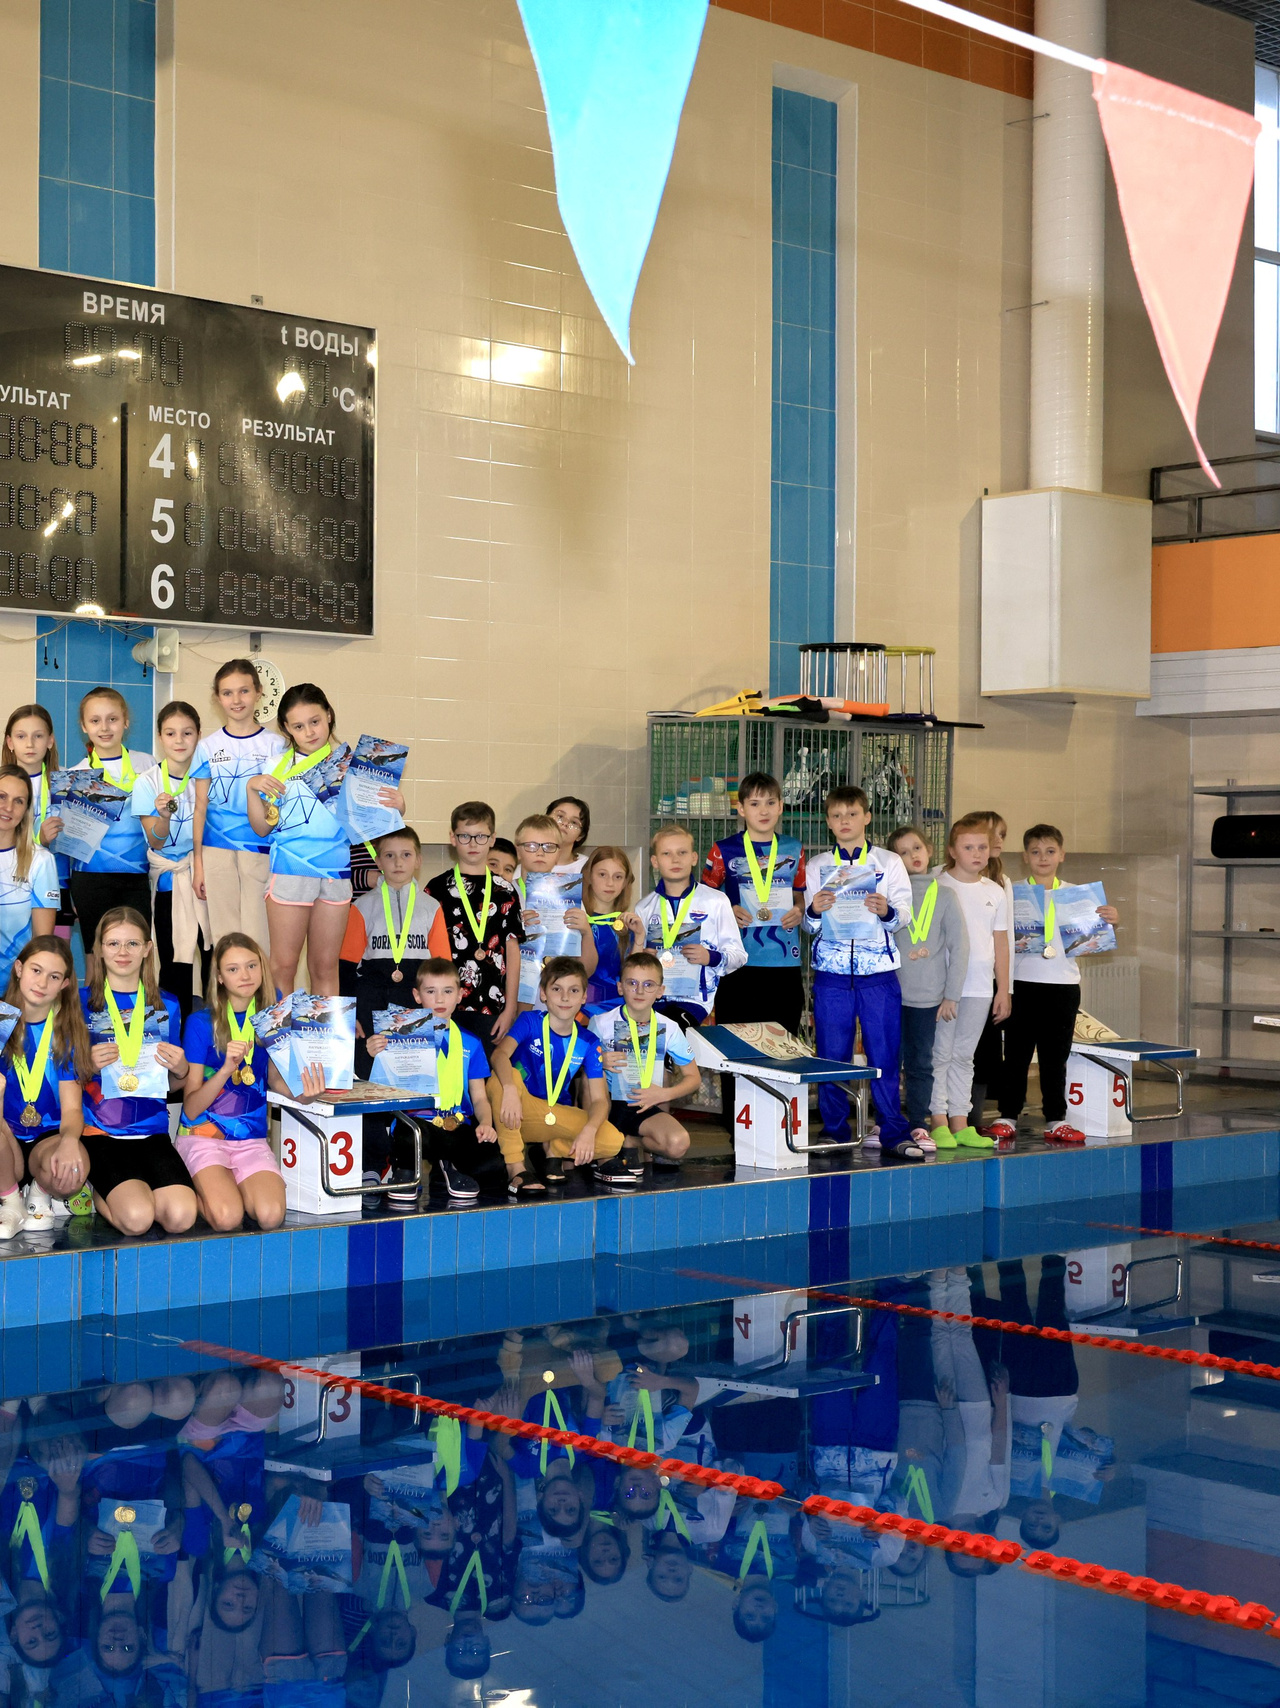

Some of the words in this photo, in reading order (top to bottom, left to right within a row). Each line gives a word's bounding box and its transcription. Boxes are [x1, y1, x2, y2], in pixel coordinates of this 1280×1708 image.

[83, 291, 165, 326] ВРЕМЯ
[295, 327, 359, 357] ВОДЫ
[149, 405, 210, 429] МЕСТО
[242, 418, 335, 446] РЕЗУЛЬТАТ
[149, 433, 175, 478] 4
[150, 498, 175, 544] 5
[150, 563, 175, 610] 6
[357, 764, 395, 782] ГРАМОТА
[72, 798, 108, 820] ГРАМОТА
[1068, 1082, 1084, 1106] 5
[1112, 1073, 1127, 1108] 5
[736, 1104, 752, 1130] 4
[781, 1096, 802, 1136] 4
[282, 1138, 297, 1169] 3
[329, 1131, 355, 1176] 3
